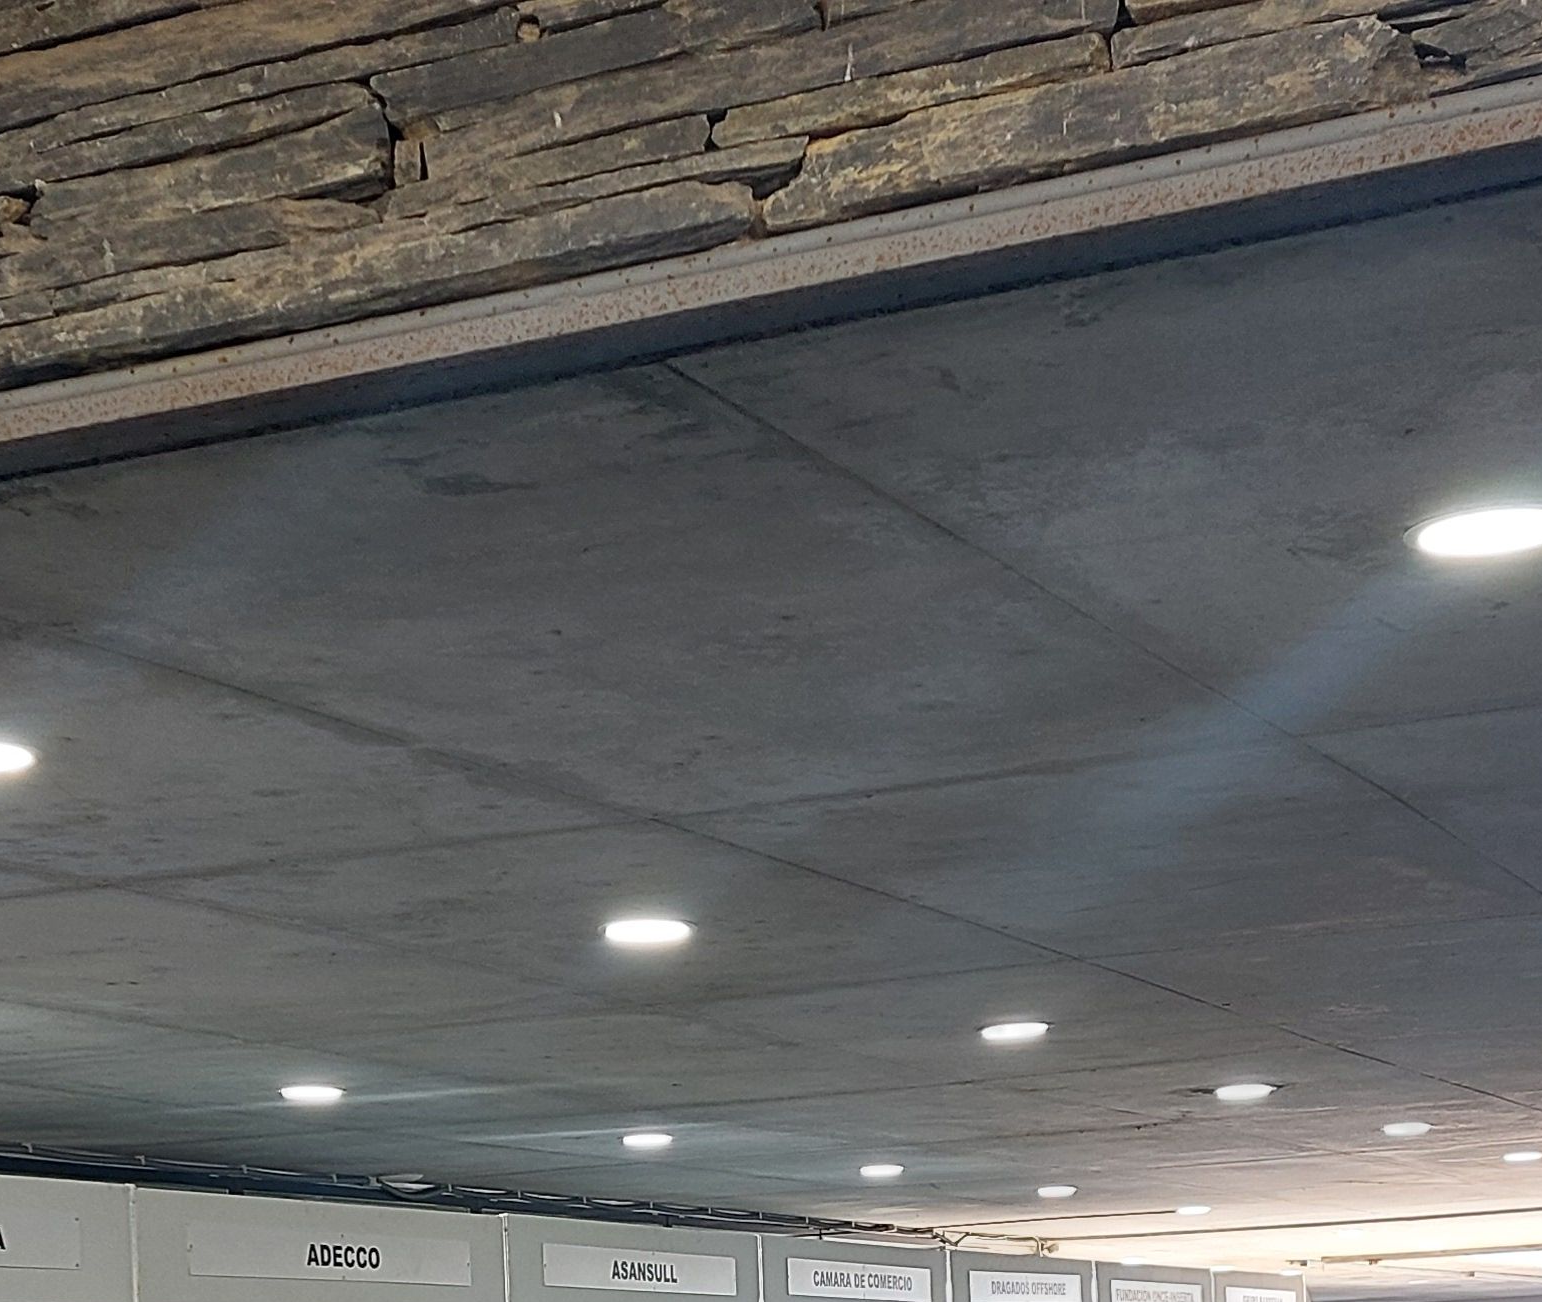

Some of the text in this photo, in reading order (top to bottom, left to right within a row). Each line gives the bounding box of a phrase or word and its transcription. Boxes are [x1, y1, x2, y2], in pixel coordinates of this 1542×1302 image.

[306, 1243, 382, 1271] ADECCO
[611, 1259, 678, 1284] ASANSULL
[813, 1269, 913, 1291] CAMARA DE COMERCIO
[991, 1281, 1066, 1295] DRAGADOS OFFSHORE
